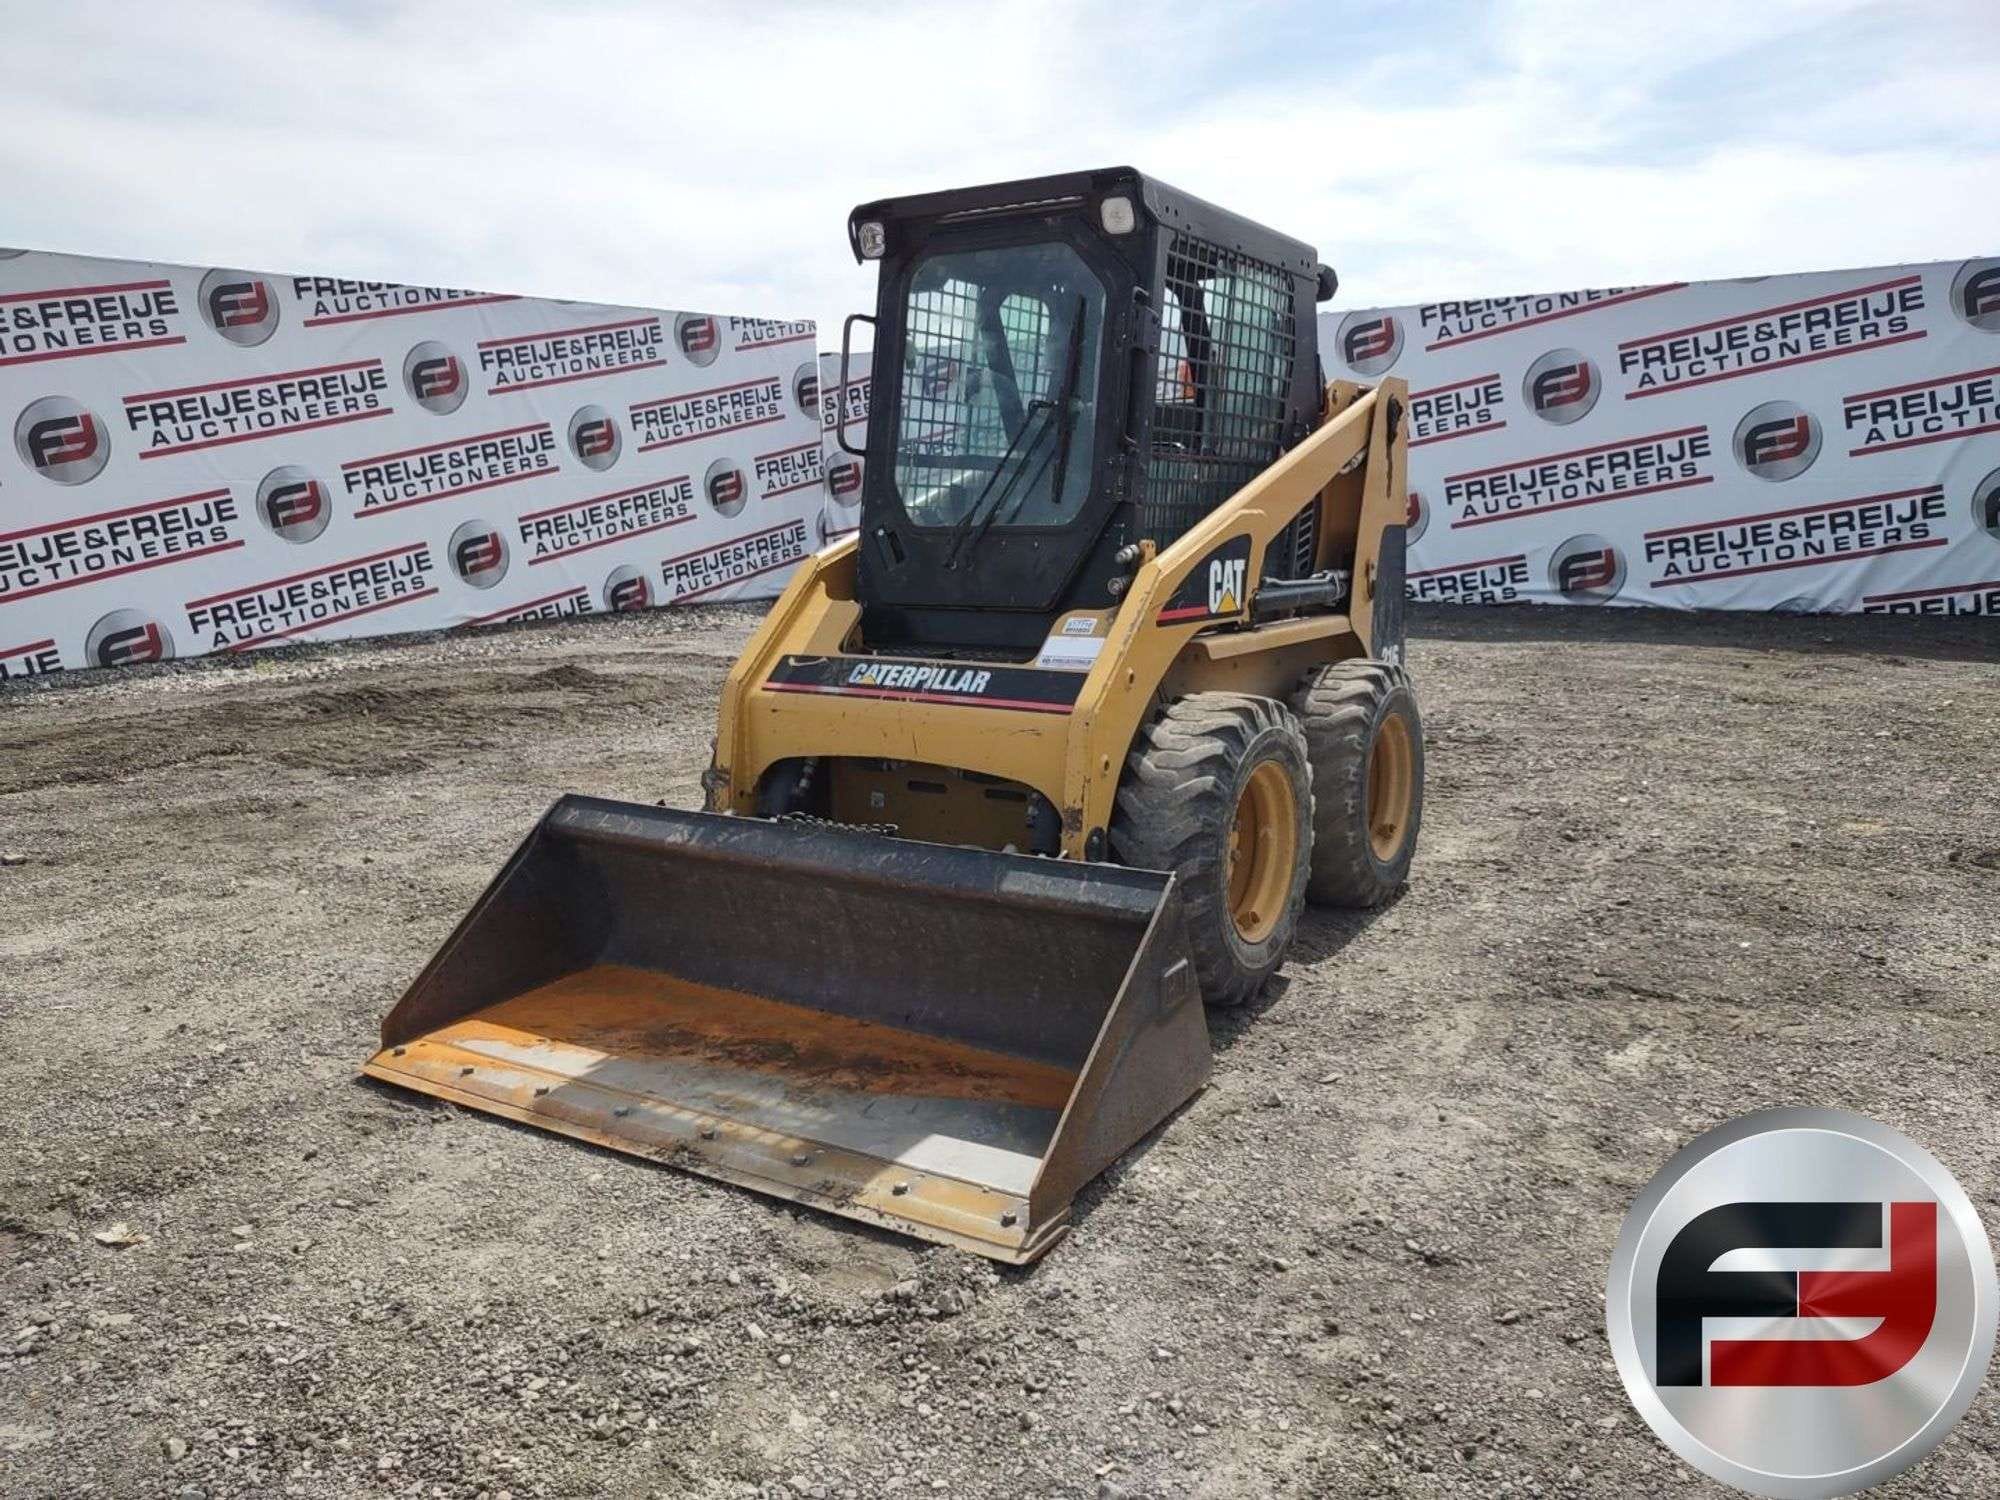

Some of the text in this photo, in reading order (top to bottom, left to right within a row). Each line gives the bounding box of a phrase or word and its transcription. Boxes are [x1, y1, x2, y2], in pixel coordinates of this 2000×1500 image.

[479, 325, 663, 371] FREIJE&FREIJE
[1619, 285, 1925, 374] FREIJE&FREIJE
[1638, 315, 1909, 388] AUCTIONEERS
[496, 347, 657, 386] AUCTIONEERS
[126, 368, 388, 431] FREIJE&FREIJE
[151, 394, 379, 447] AUCTIONEERS
[631, 383, 783, 431] FREIJE&FREIJE
[645, 404, 778, 443] AUCTIONEERS
[1865, 404, 2000, 445] AUCTI
[344, 431, 556, 493] FREIJE&FREIJE
[364, 454, 548, 508] AUCTIONEERS
[1445, 435, 1712, 505] FREIJE&FREIJE
[519, 482, 694, 544] FREIJE&FREIJE
[1462, 462, 1698, 519] AUCTIONEERS
[536, 504, 688, 556] AUCTIONEERS
[662, 525, 807, 586] FREIJE&FREIJE
[1645, 495, 1947, 562] FREIJE&FREIJE
[1663, 523, 1930, 578] AUCTIONEERS
[188, 551, 434, 635] FREIJE&FREIJE
[675, 544, 802, 596] AUCTIONEERS
[1209, 558, 1246, 613] CAT
[212, 576, 425, 648] AUCTIONEERS
[850, 662, 992, 693] CATERPILLAR
